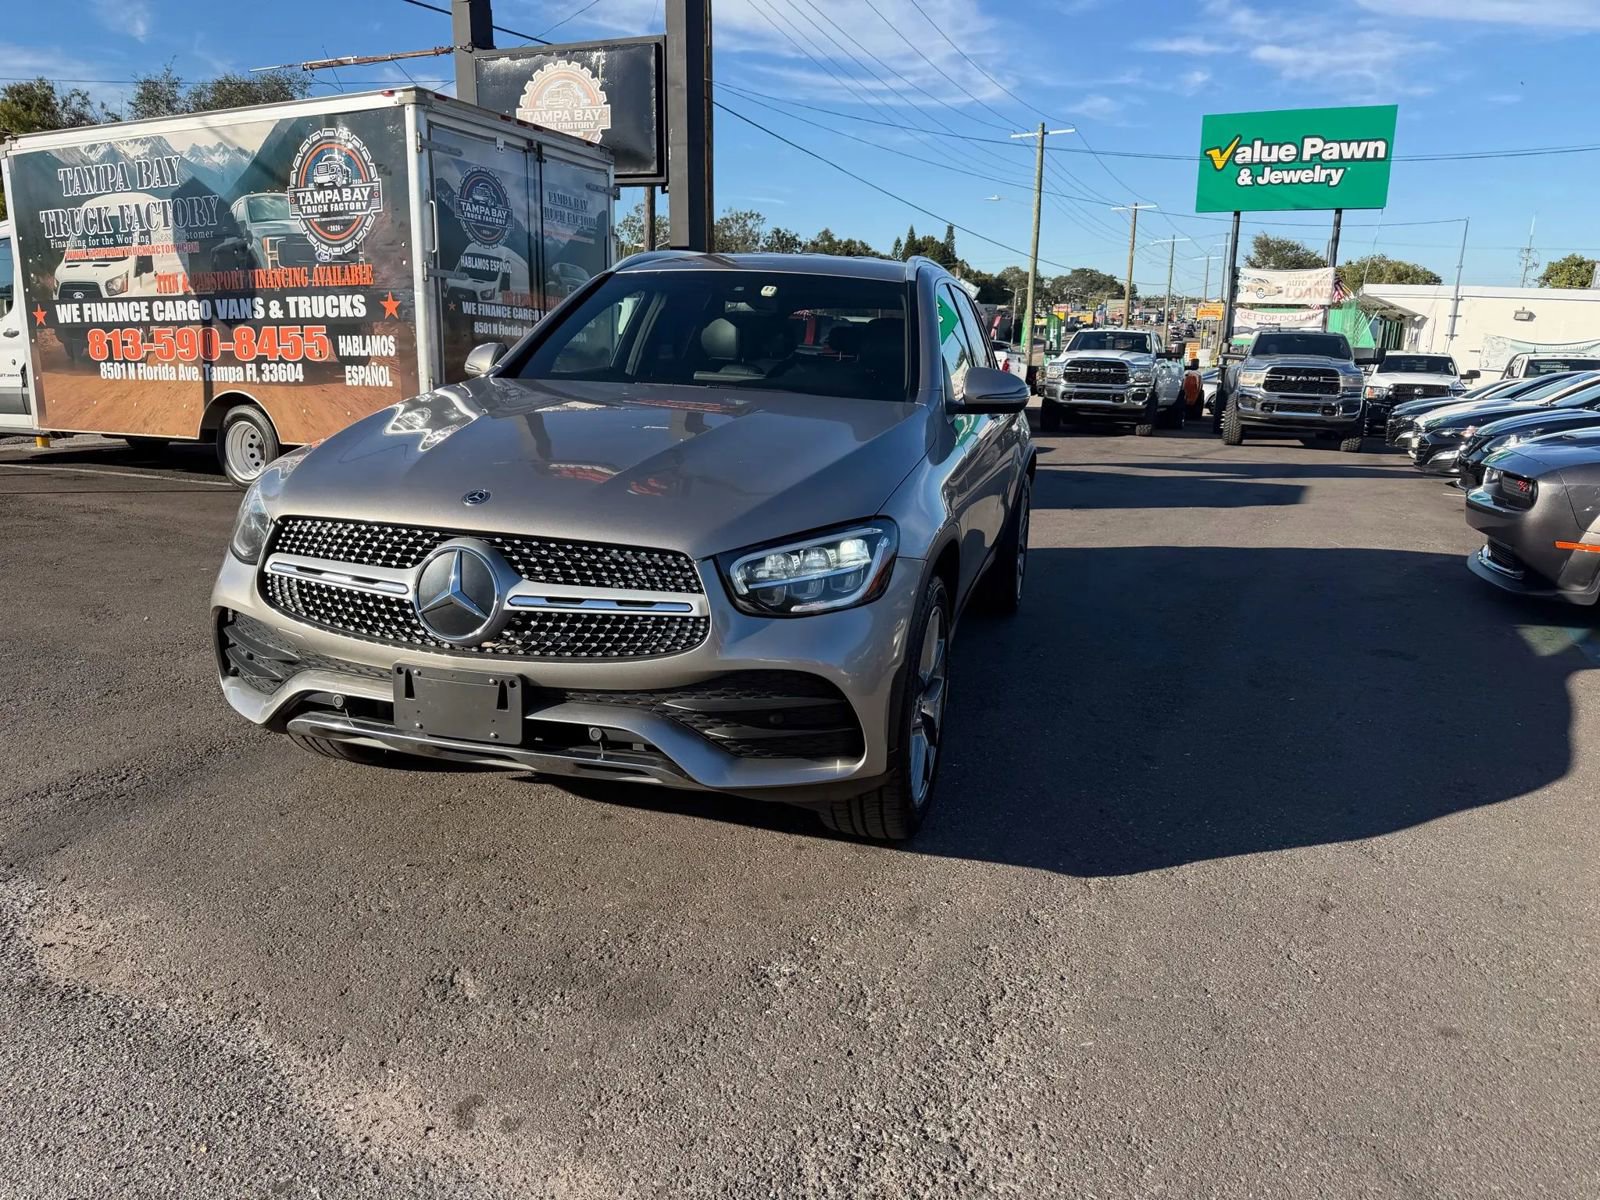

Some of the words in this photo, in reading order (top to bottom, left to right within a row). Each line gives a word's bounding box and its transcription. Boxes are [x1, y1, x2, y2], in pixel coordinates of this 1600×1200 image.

[524, 110, 570, 123] TAMPA
[574, 108, 601, 121] BAY
[558, 121, 595, 129] FACTORY
[1302, 137, 1387, 161] Pawn
[58, 161, 131, 197] TAMPA
[136, 155, 180, 190] BAY
[1237, 168, 1253, 186] &
[1257, 165, 1344, 186] Jewelry
[297, 188, 342, 205] TAMPA
[342, 186, 371, 202] BAY
[39, 205, 113, 238] TRUCK
[118, 195, 219, 233] FACTORY
[302, 204, 328, 214] TRUCK
[330, 202, 367, 212] FACTORY
[460, 201, 491, 216] TAMPA
[491, 208, 507, 219] BAY
[88, 236, 99, 246] for
[102, 235, 114, 245] the
[248, 267, 308, 289] FINANCING
[312, 263, 373, 287] AVAILABLE
[1285, 287, 1332, 299] LOANS
[55, 303, 81, 324] WE
[84, 301, 150, 323] FINANCE
[152, 299, 213, 322] CARGO
[215, 296, 266, 320] VANS
[268, 299, 284, 319] &
[286, 294, 367, 319] TRUCKS
[462, 301, 477, 315] WE
[478, 303, 512, 318] FINANCE
[512, 307, 540, 321] CARGO
[1240, 311, 1257, 320] GET
[1279, 313, 1318, 321] DOLLAR
[474, 321, 491, 335] 8501
[499, 321, 522, 337] Florida
[87, 325, 329, 361] 813-590-8455
[338, 335, 396, 357] HABLAMOS
[100, 362, 126, 380] 8501
[128, 363, 134, 380] N
[137, 362, 177, 381] Florida
[178, 363, 203, 381] Ave.
[204, 363, 244, 384] Tampa
[261, 363, 304, 383] 33604
[345, 361, 393, 387] ESPAÑOL
